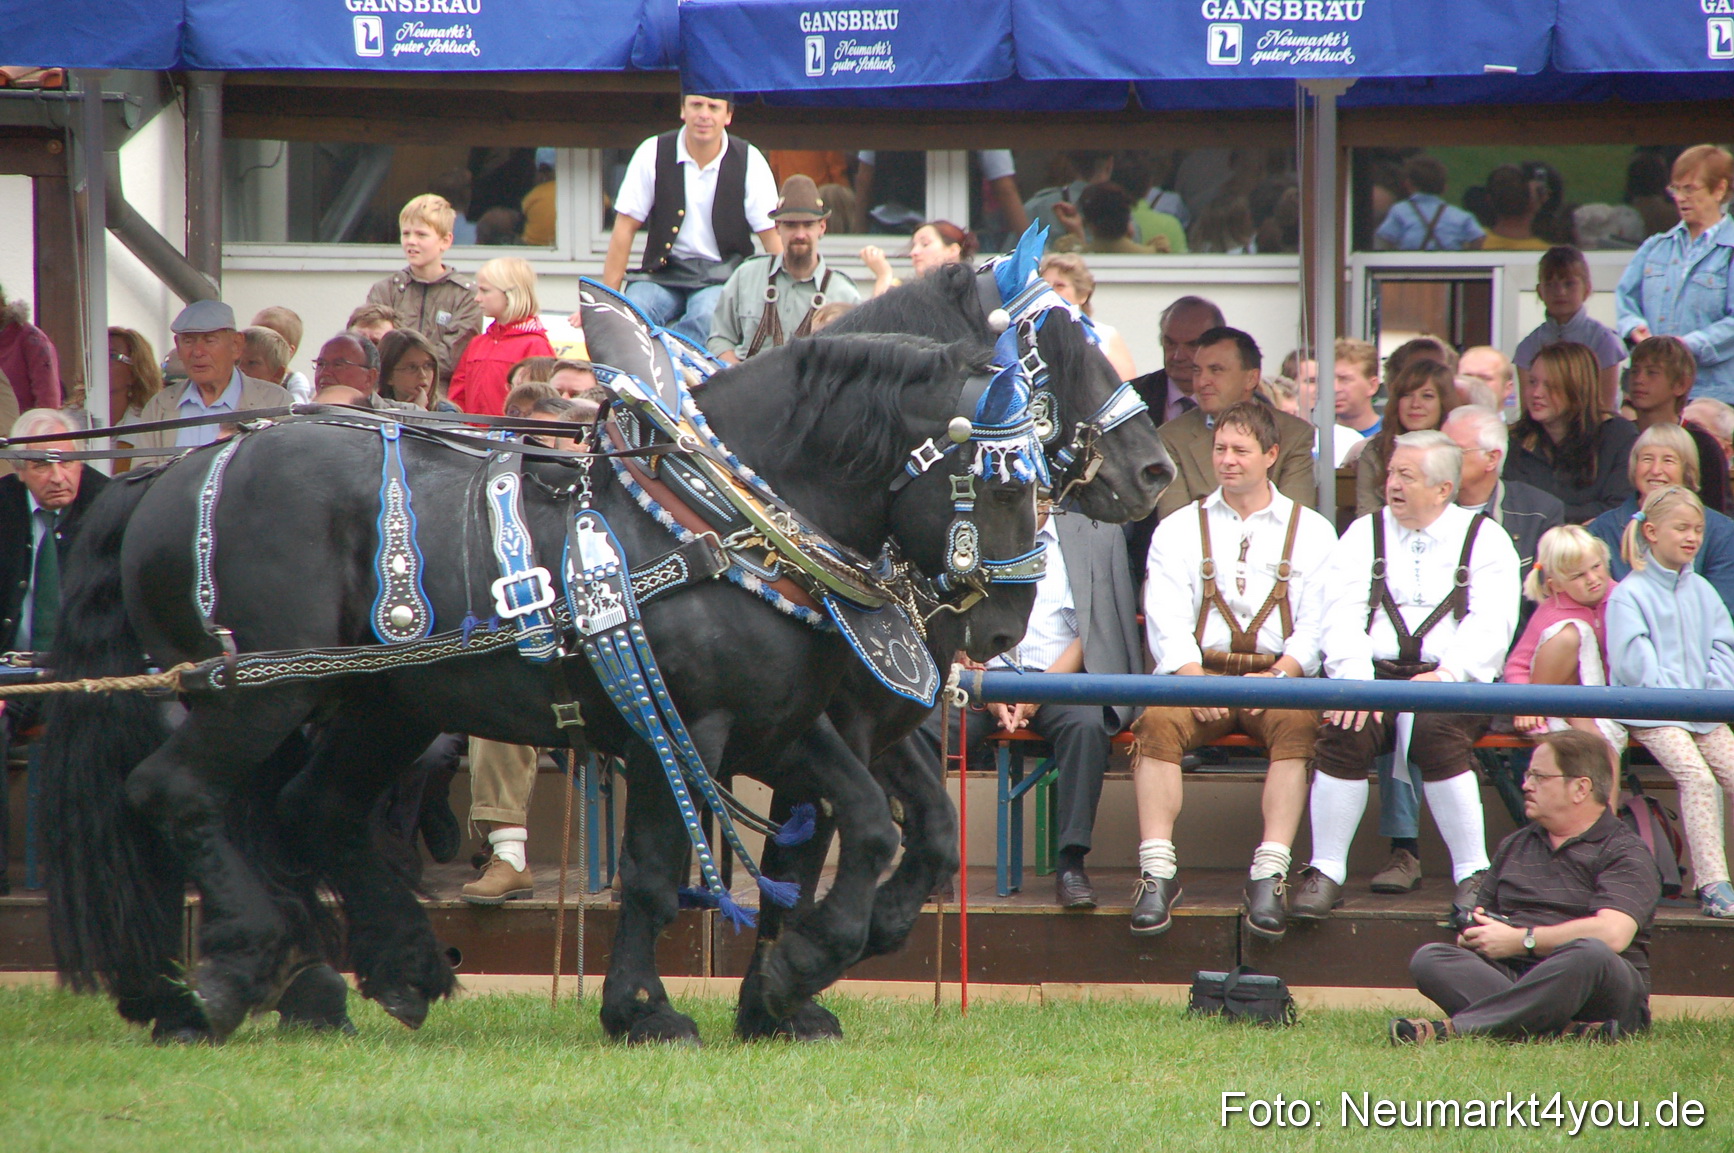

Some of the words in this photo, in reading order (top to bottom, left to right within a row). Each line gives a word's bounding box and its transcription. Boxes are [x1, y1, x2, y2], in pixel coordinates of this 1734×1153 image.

[1201, 0, 1364, 20] GANSBRÄU
[1701, 0, 1734, 14] GA
[800, 9, 899, 32] GANSBRÄU
[396, 21, 472, 41] Neumarkt's
[1257, 29, 1349, 49] Neumarkt's
[392, 41, 424, 57] guter
[424, 39, 480, 57] Schluck
[834, 39, 891, 59] Neumarkt's
[1250, 49, 1291, 65] guter
[1290, 47, 1356, 64] Schluck
[831, 58, 857, 76] guter
[855, 57, 896, 74] Schluck
